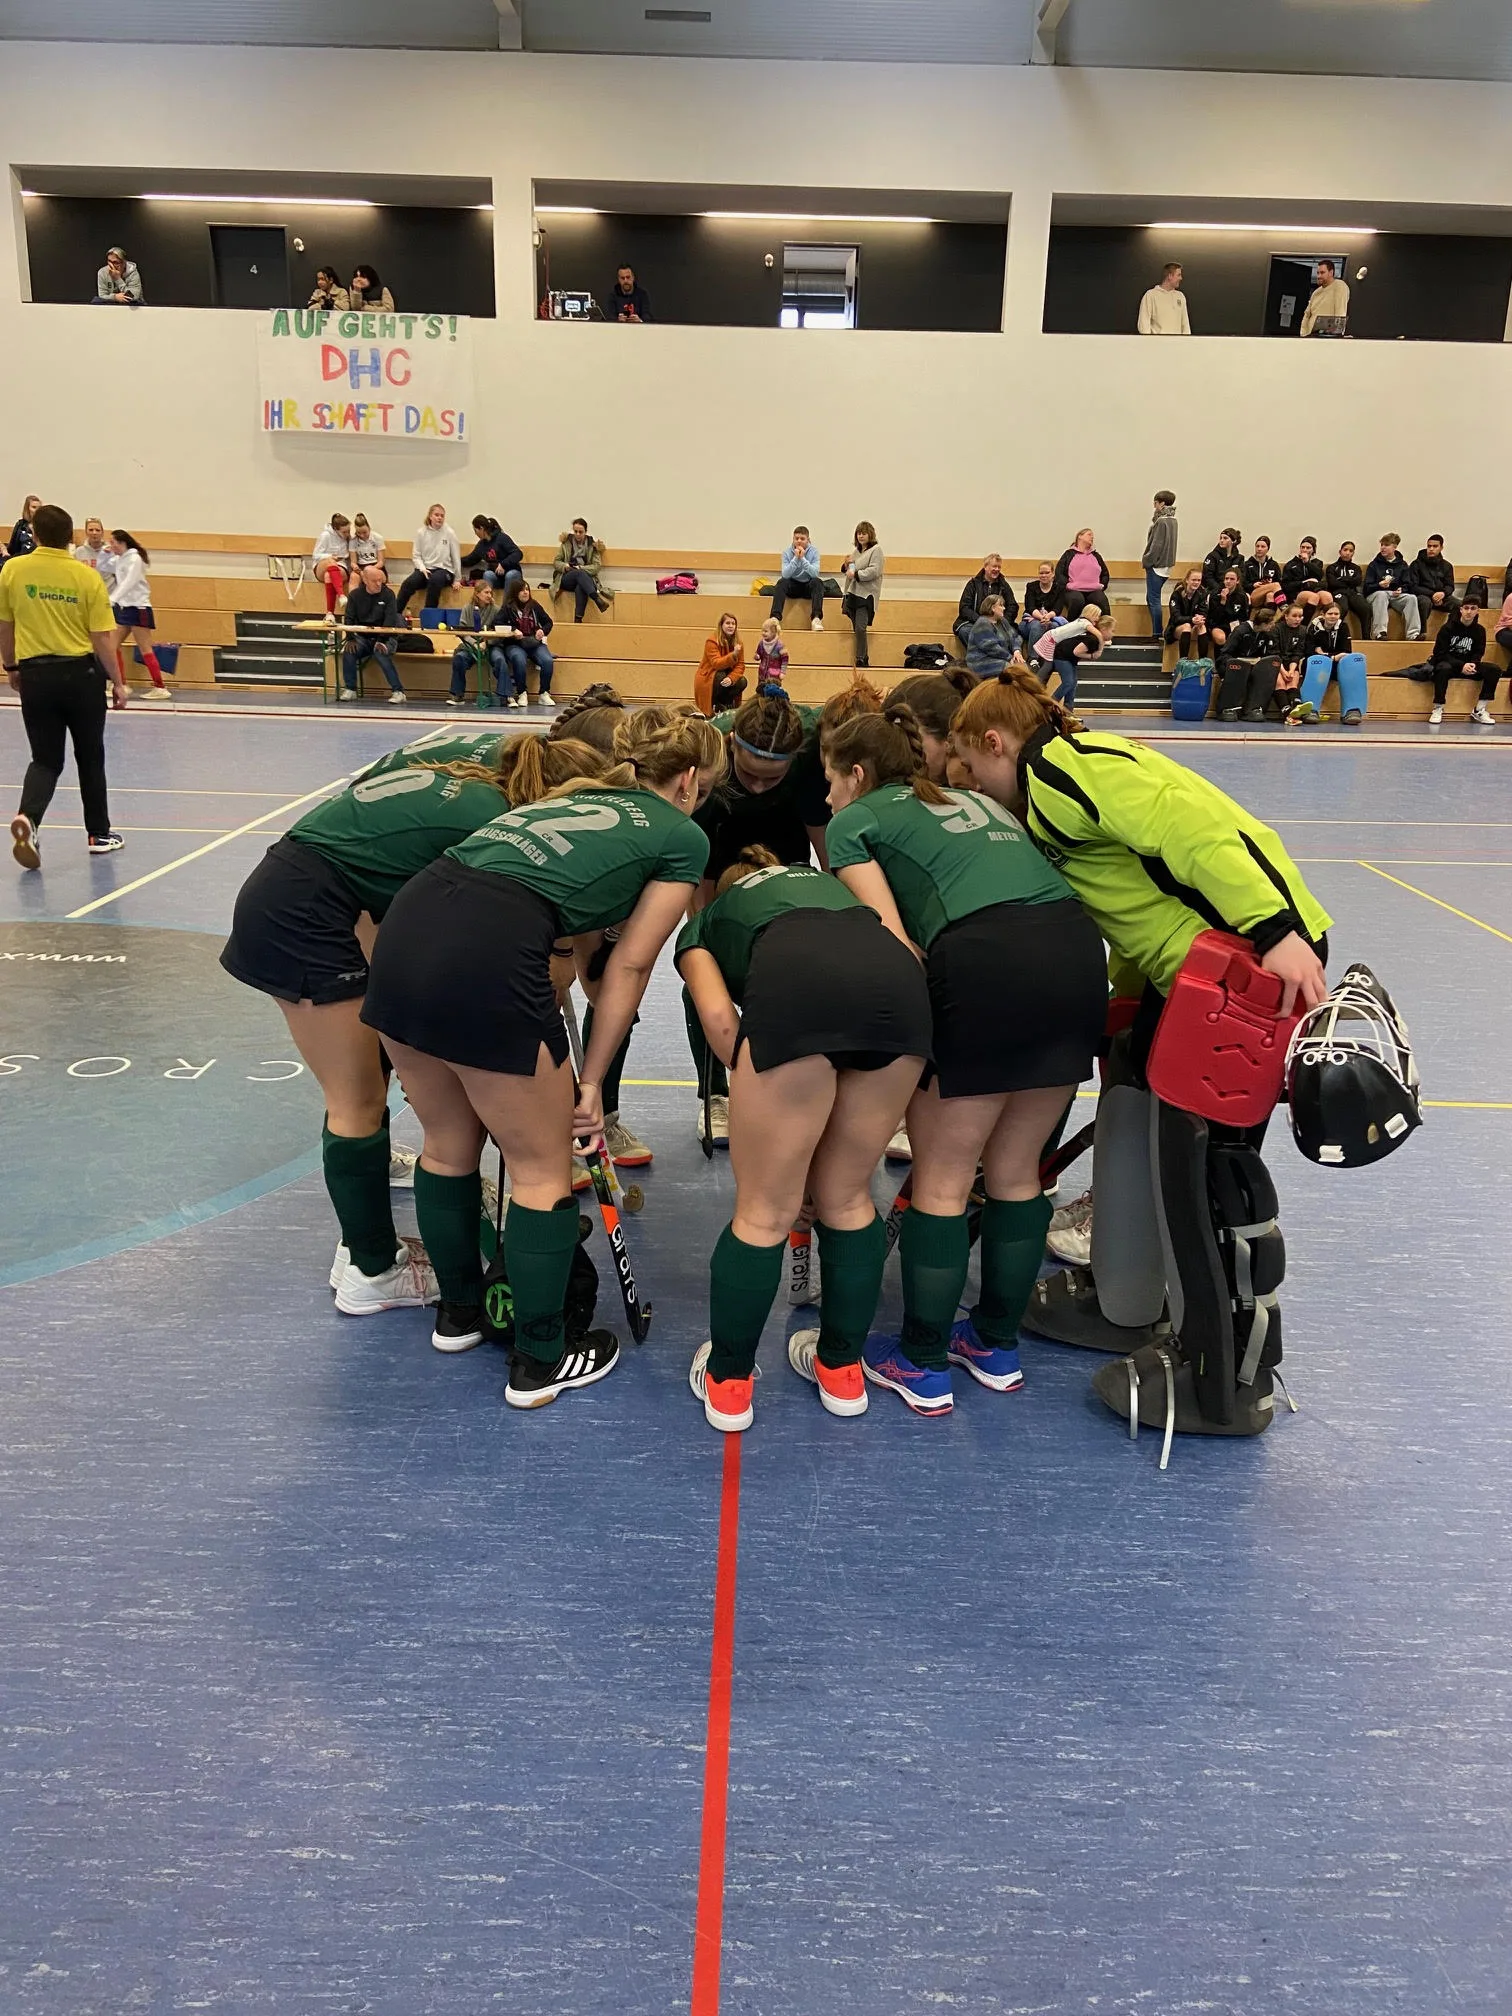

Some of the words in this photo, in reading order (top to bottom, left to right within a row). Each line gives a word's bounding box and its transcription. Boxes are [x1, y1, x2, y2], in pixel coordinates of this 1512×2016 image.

[250, 264, 258, 275] 4
[272, 309, 330, 338] AUF
[321, 344, 411, 389] DHC
[264, 398, 301, 430] IHR
[312, 402, 395, 433] SCHAFFT
[404, 405, 465, 441] DAS!
[487, 796, 621, 857] 22
[986, 831, 1021, 842] MEYER
[541, 832, 554, 843] CR
[0, 952, 127, 963] www.x
